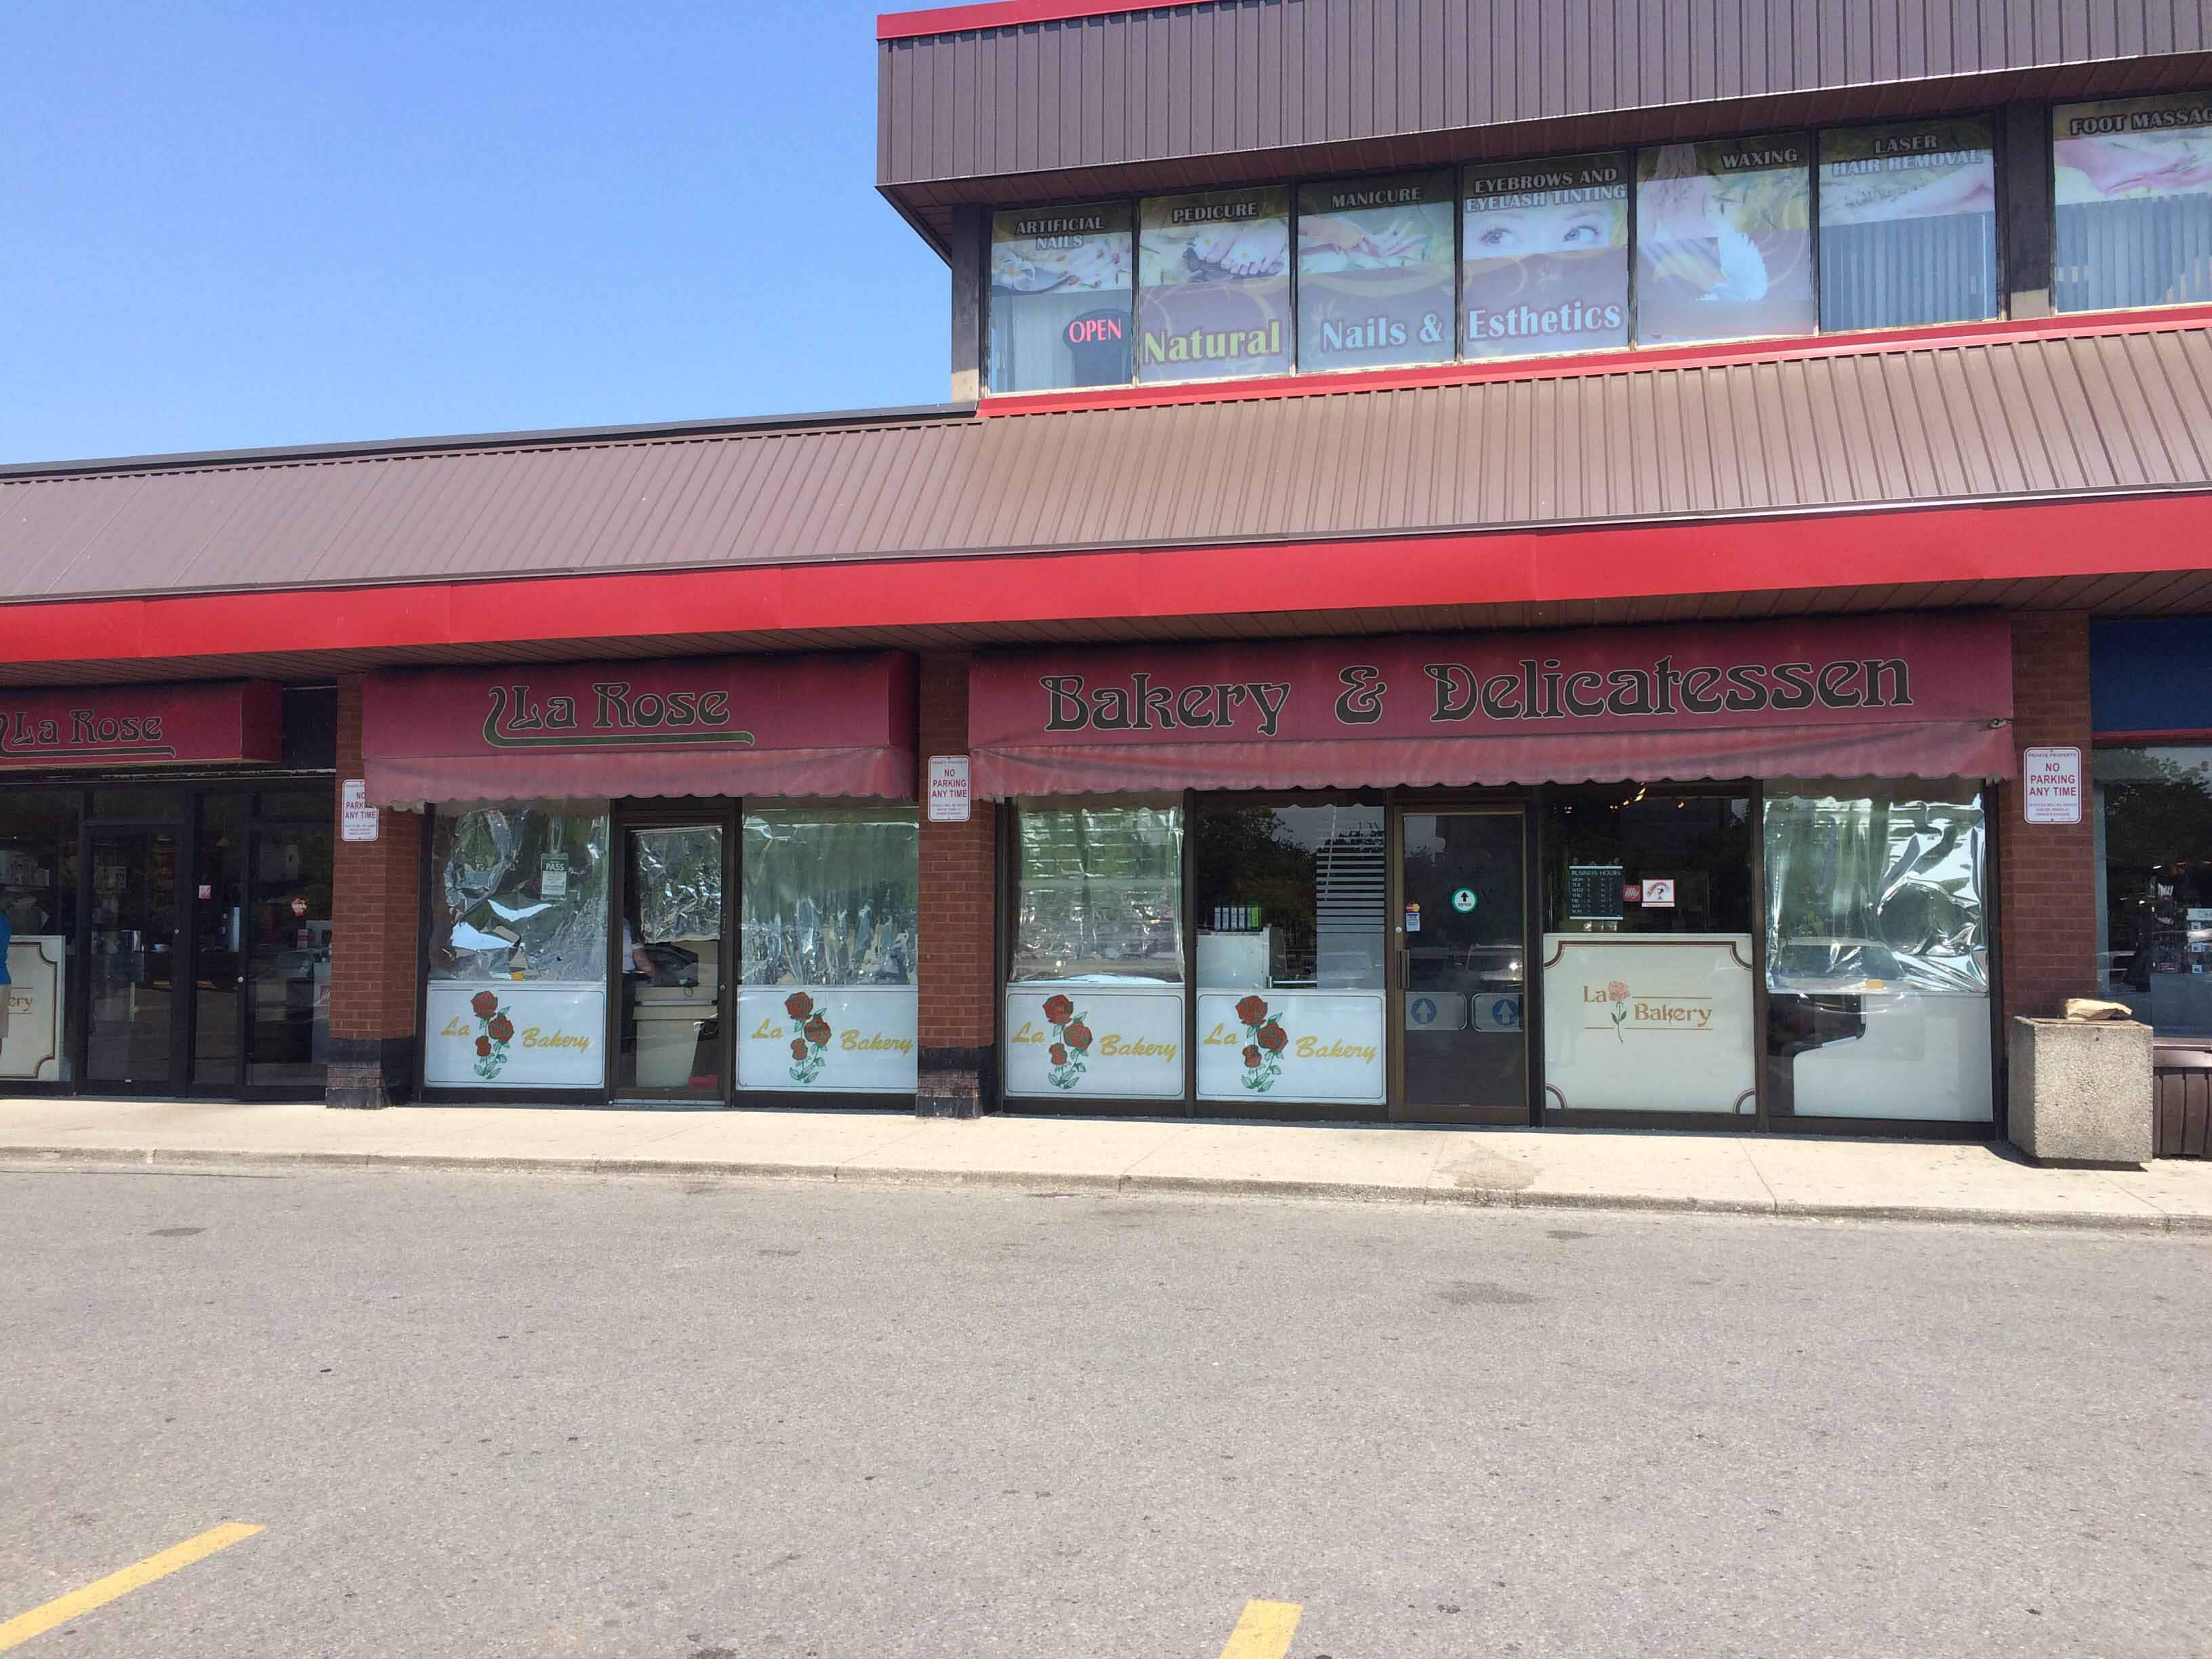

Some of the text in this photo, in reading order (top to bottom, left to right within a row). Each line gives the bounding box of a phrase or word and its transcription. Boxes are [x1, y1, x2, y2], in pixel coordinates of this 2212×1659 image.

[2071, 108, 2212, 135] FOOT MASSAG
[1875, 135, 1938, 154] LASER
[1723, 148, 1799, 168] WAXING
[1832, 150, 1983, 176] HAIR REMOVAL
[1475, 167, 1617, 193] EYEBROWS AND
[1332, 186, 1421, 208] MANICURE
[1466, 184, 1626, 212] EYELASH TINTING
[1172, 203, 1258, 223] PEDICURE
[1015, 217, 1105, 236] ARTIFICIAL
[1036, 235, 1084, 250] NAILS
[1069, 318, 1122, 343] OPEN
[1143, 302, 1622, 364] Natural Nails & Esthetics
[509, 682, 730, 730] La Rose
[1040, 655, 1914, 736] Bakery & Delicatessen
[11, 710, 163, 745] La Rose
[944, 769, 955, 777] NO
[2030, 775, 2075, 783] PARKING
[2045, 763, 2060, 771] NO
[2030, 787, 2076, 796] ANY TIME
[546, 863, 565, 871] PASS
[1583, 986, 1712, 1027] La Bakery
[441, 1015, 591, 1053] La Bakery
[752, 1019, 914, 1057] La Bakery
[1011, 1021, 1177, 1063] La Bakery
[1203, 1023, 1378, 1065] La Bakery
